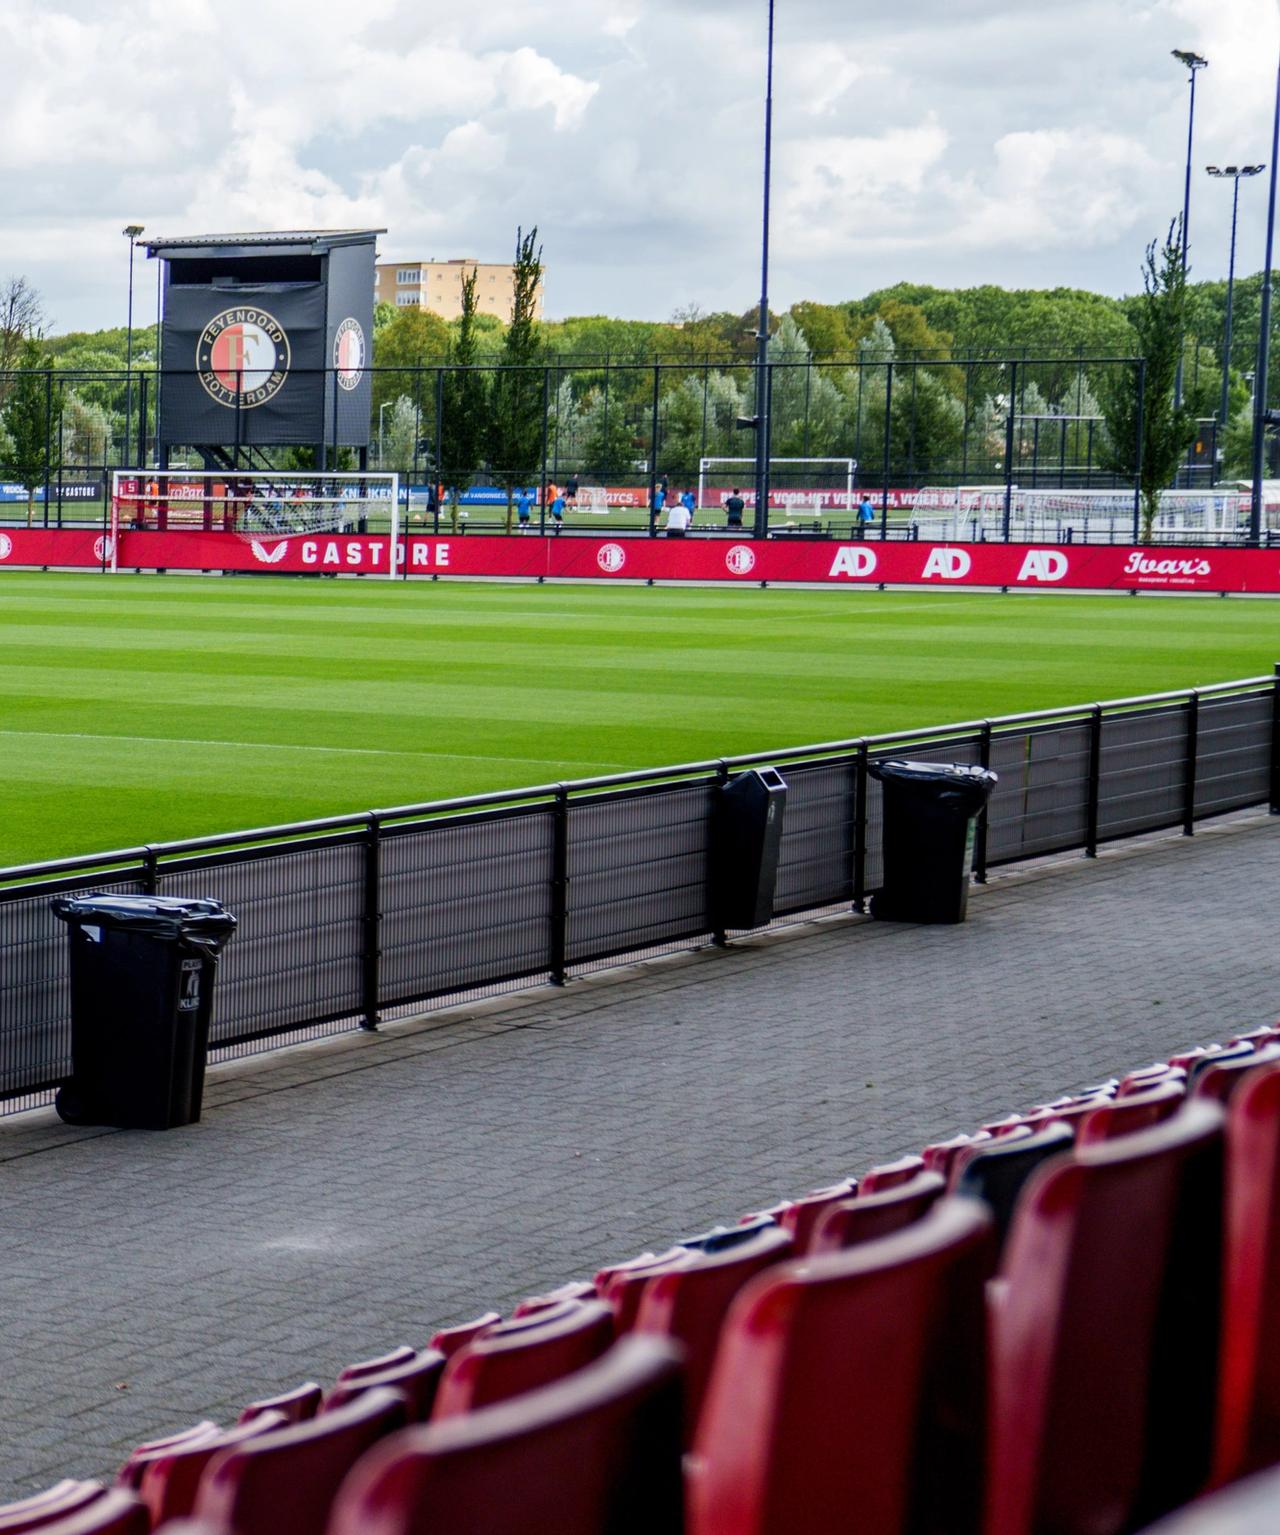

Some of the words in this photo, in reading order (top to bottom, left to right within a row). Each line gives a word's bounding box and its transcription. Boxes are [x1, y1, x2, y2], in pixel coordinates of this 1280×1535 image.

[203, 311, 283, 345] FEYENOORD
[203, 371, 283, 405] ROTTERDAM
[301, 541, 450, 566] CASTORE
[828, 546, 877, 577] AD
[921, 547, 971, 579] AD
[1017, 550, 1069, 581] AD
